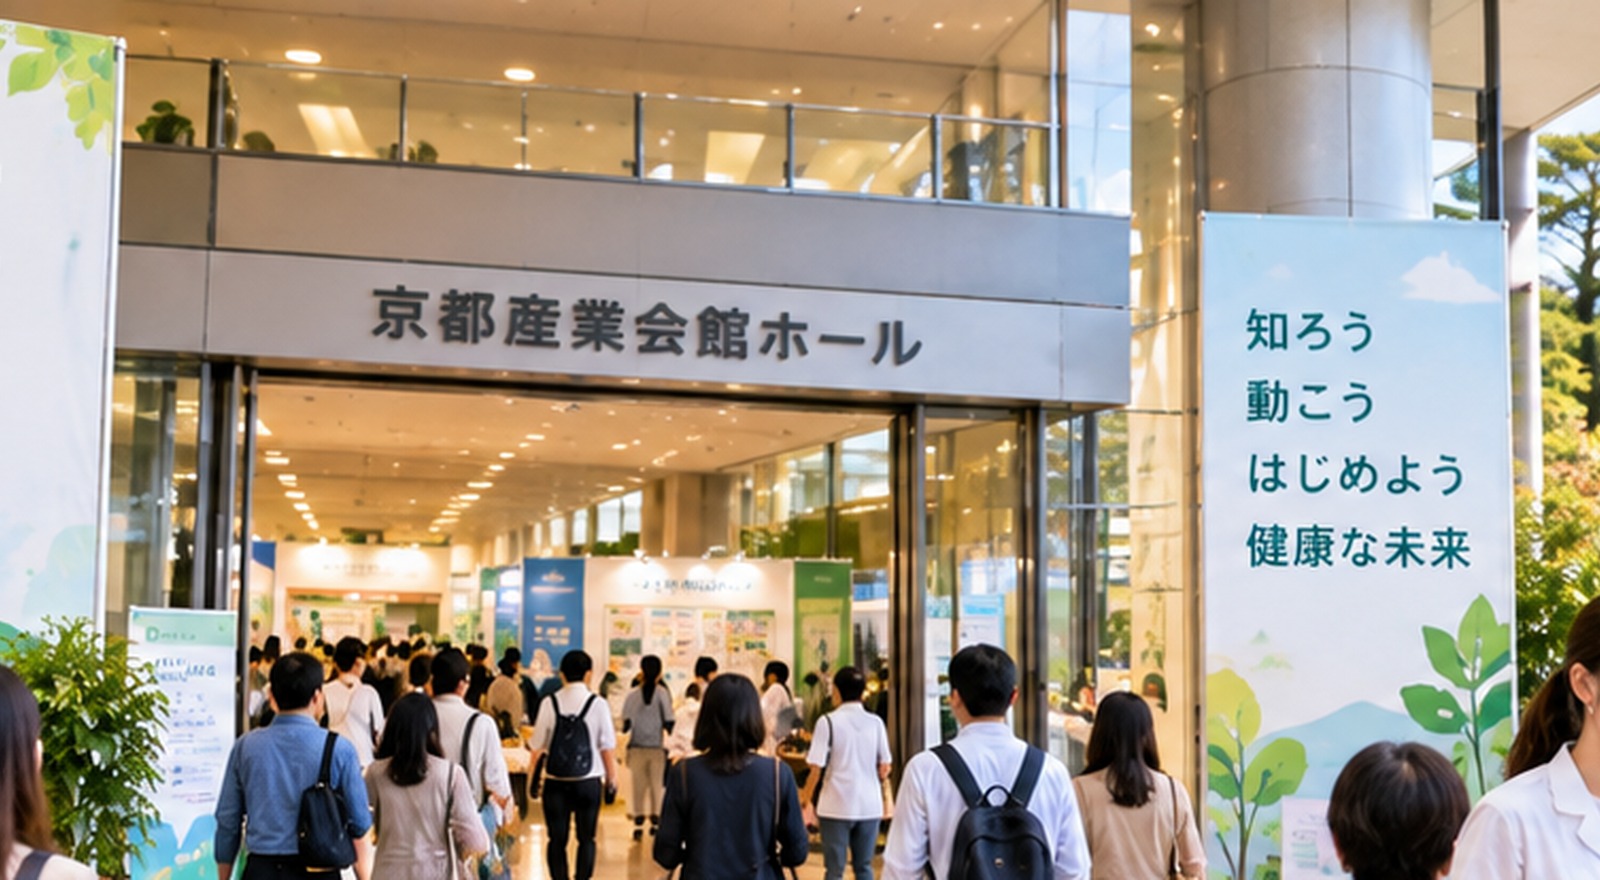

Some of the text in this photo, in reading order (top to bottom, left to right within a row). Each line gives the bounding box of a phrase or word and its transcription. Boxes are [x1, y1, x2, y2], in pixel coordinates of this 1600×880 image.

[372, 284, 922, 367] 京都産業会館ホール
[1246, 308, 1373, 352] 知ろう
[1246, 379, 1373, 423] 動こう
[1249, 453, 1463, 495] はじめよう
[1246, 523, 1471, 570] 健康な未来
